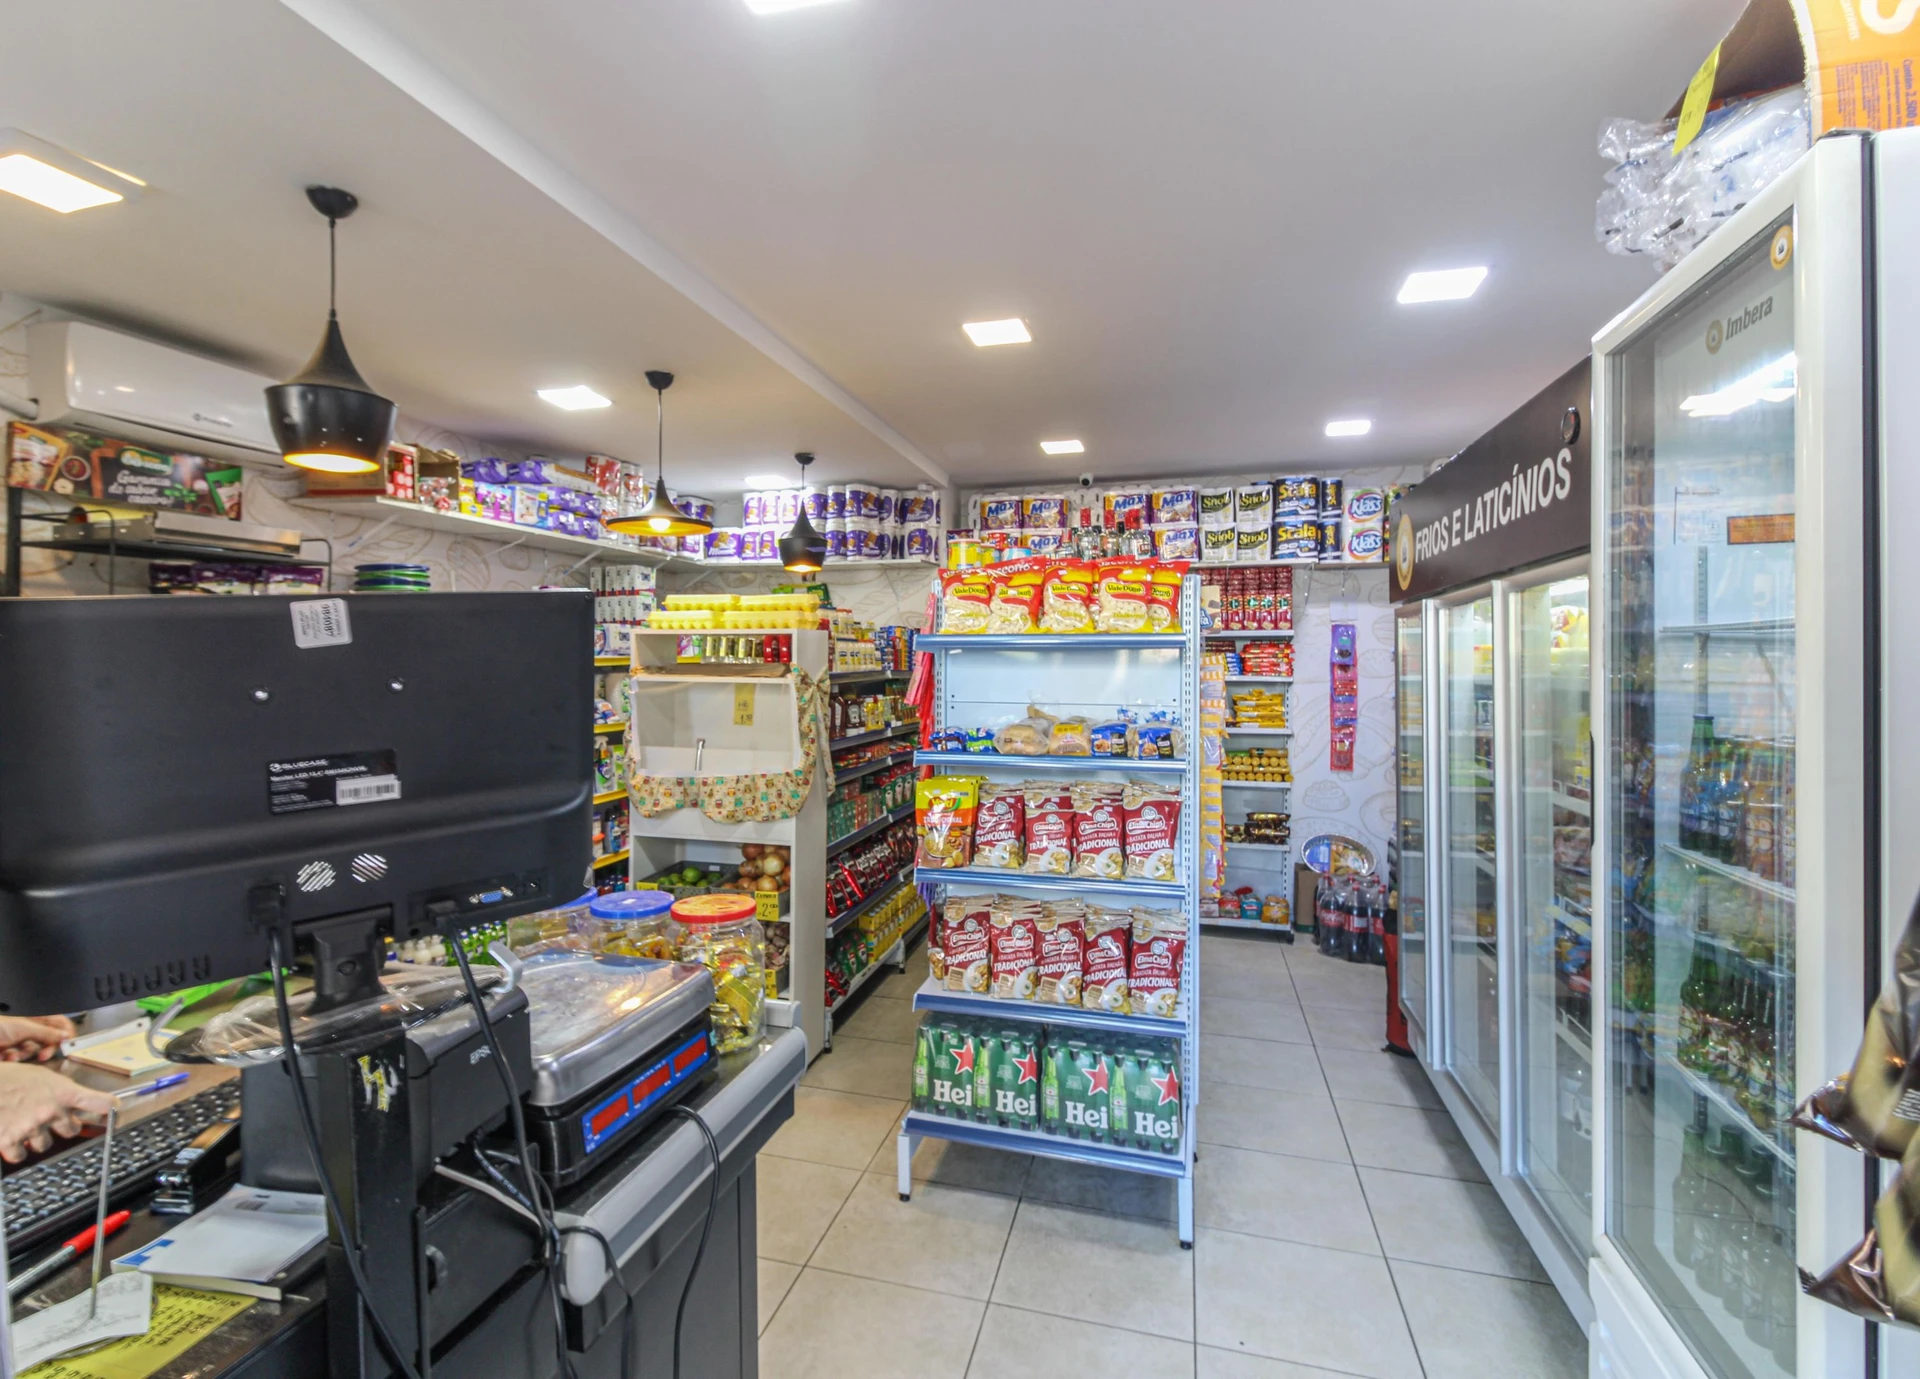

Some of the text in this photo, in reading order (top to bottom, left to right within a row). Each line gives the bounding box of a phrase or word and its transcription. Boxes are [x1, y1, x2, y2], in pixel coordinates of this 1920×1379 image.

[1725, 296, 1773, 341] Imbera
[1278, 482, 1317, 499] Scala
[1030, 499, 1060, 514] Max
[1114, 494, 1144, 511] Max
[1161, 491, 1193, 508] Max
[1415, 447, 1572, 563] FRIOS E LATICÍNIOS
[987, 500, 1016, 517] Max
[1030, 533, 1059, 549] Max
[1165, 529, 1195, 544] Max
[1206, 529, 1234, 544] Snob
[1238, 530, 1267, 545] Snob
[1277, 523, 1317, 542] Scala
[975, 830, 1016, 843] RADICIONAL
[1077, 838, 1120, 852] RADICIONAL
[1126, 838, 1170, 854] RADICIONAL
[933, 1079, 972, 1106] Hei
[996, 1089, 1036, 1116] Hei
[1065, 1101, 1108, 1129] Hei
[1134, 1111, 1178, 1139] Hei
